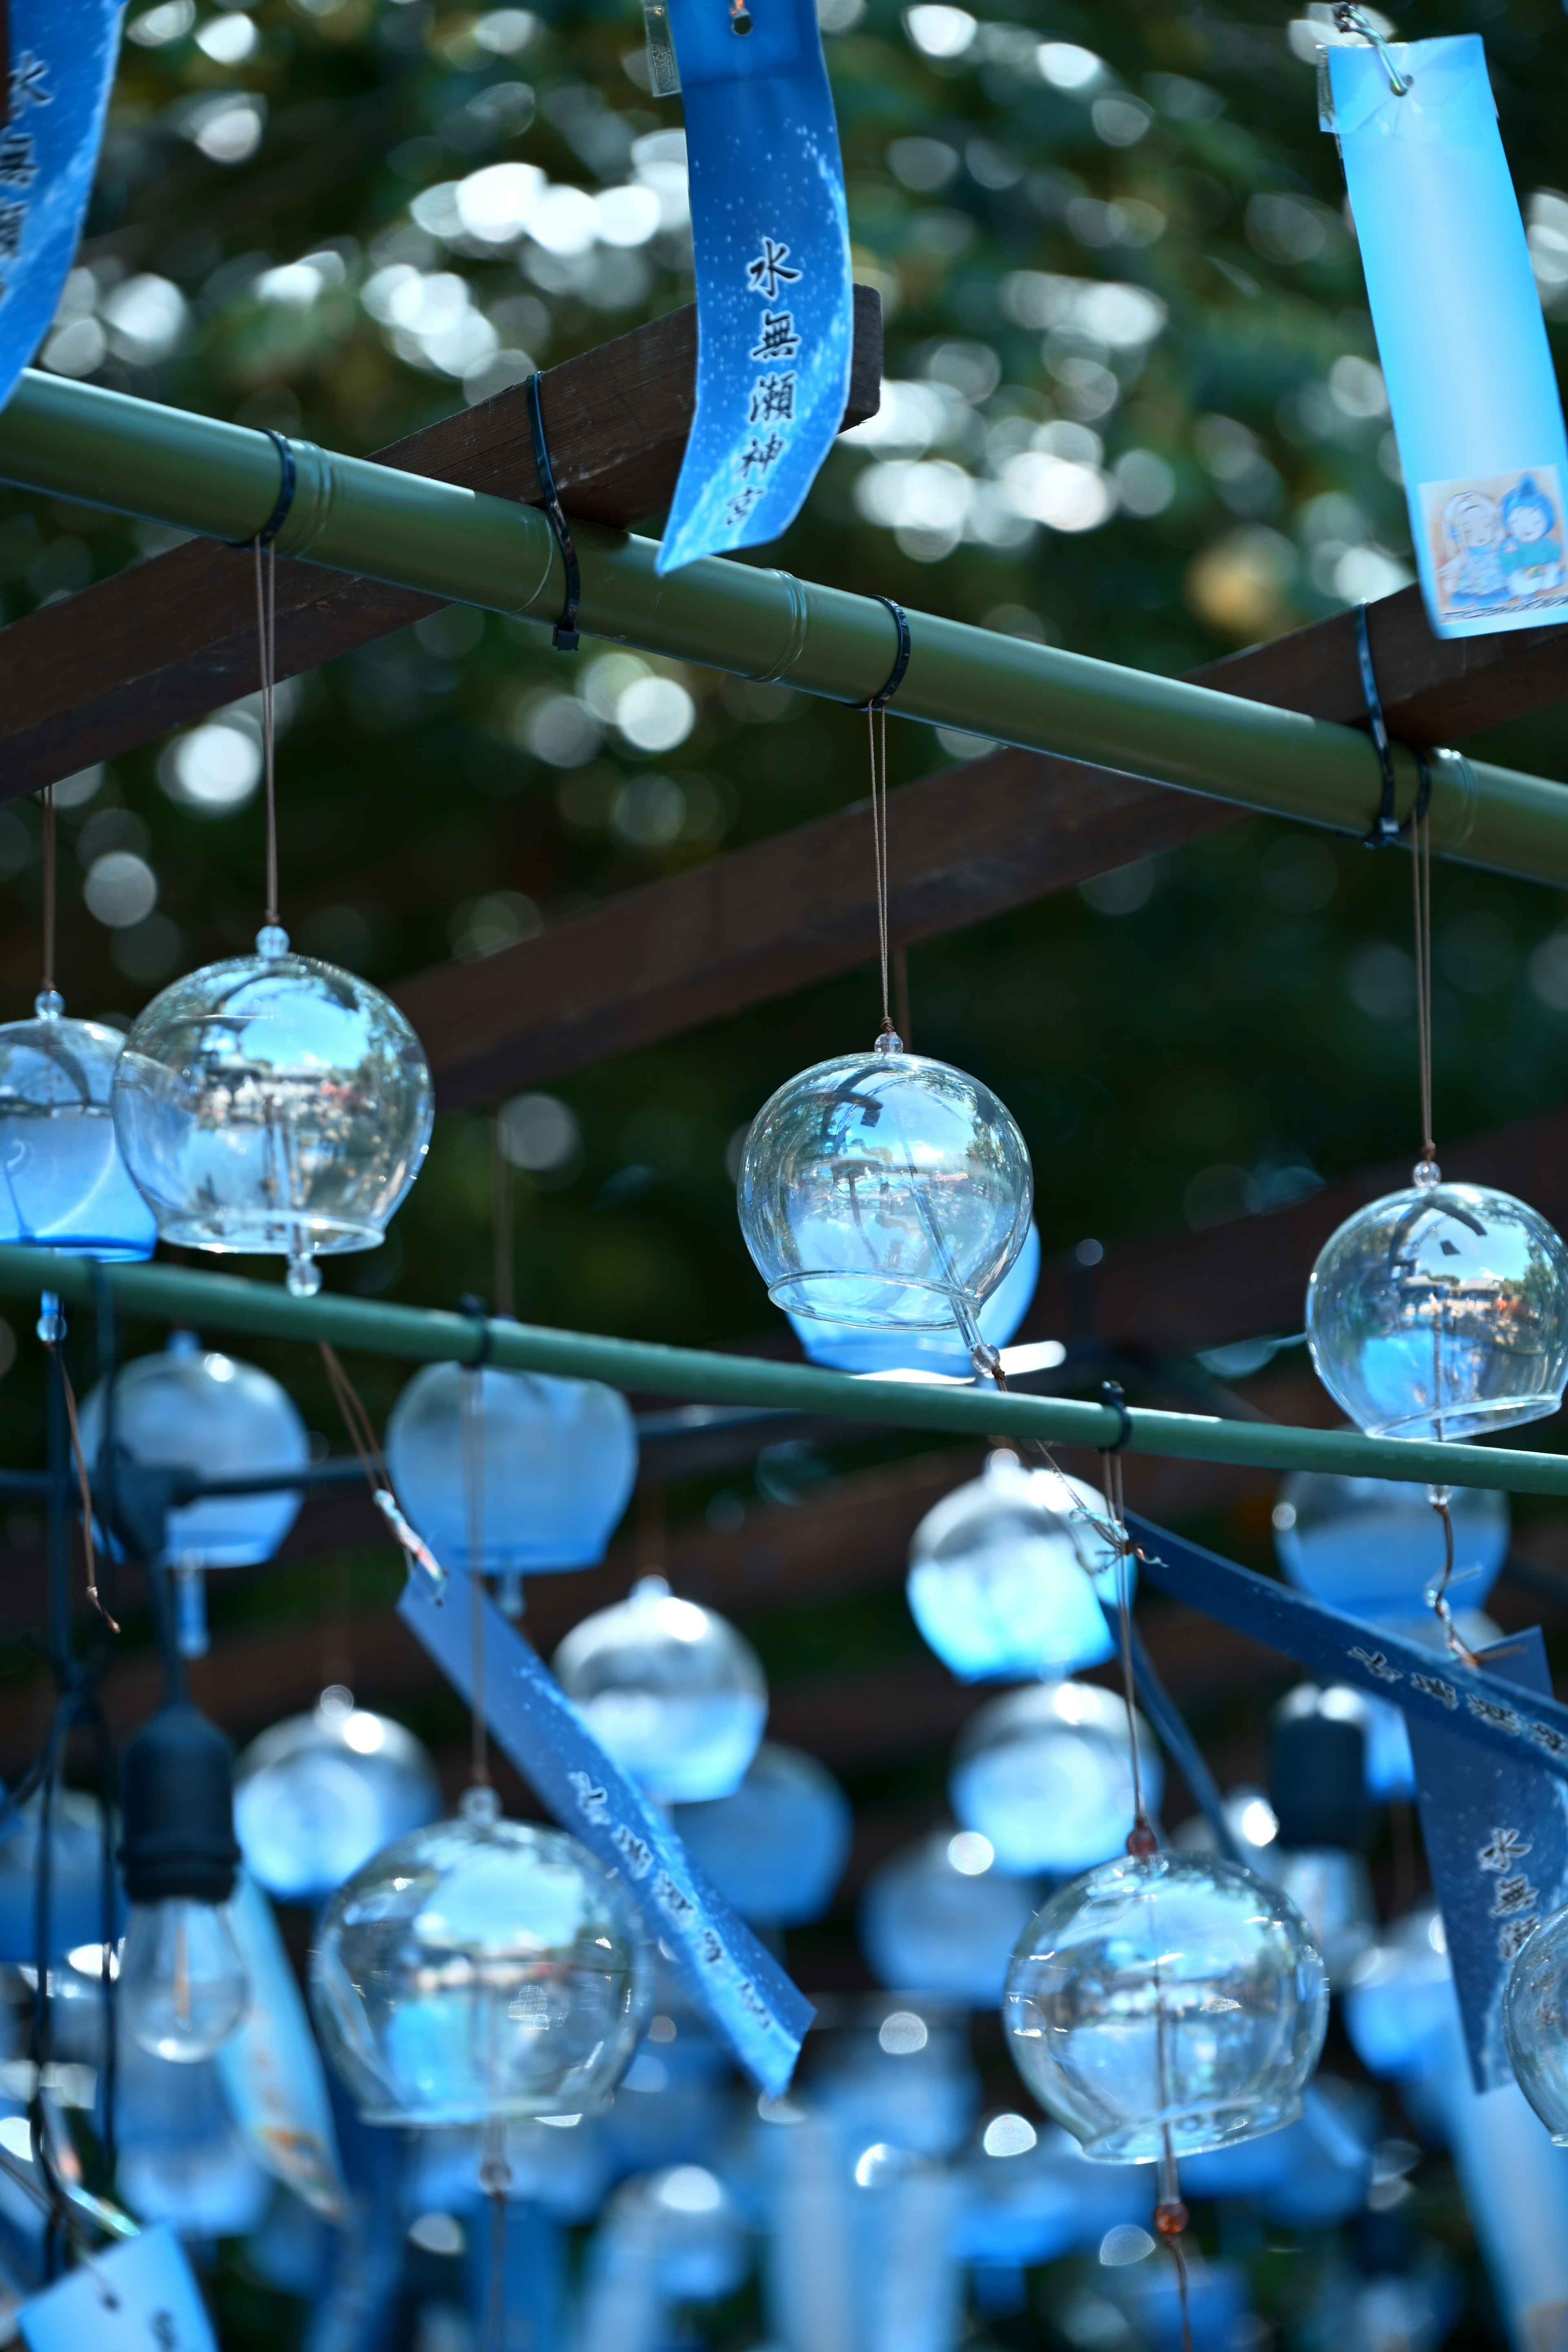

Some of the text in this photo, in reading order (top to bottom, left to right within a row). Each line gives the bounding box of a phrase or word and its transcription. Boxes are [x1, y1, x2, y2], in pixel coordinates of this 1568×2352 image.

[725, 238, 801, 527] 水無瀬神宮
